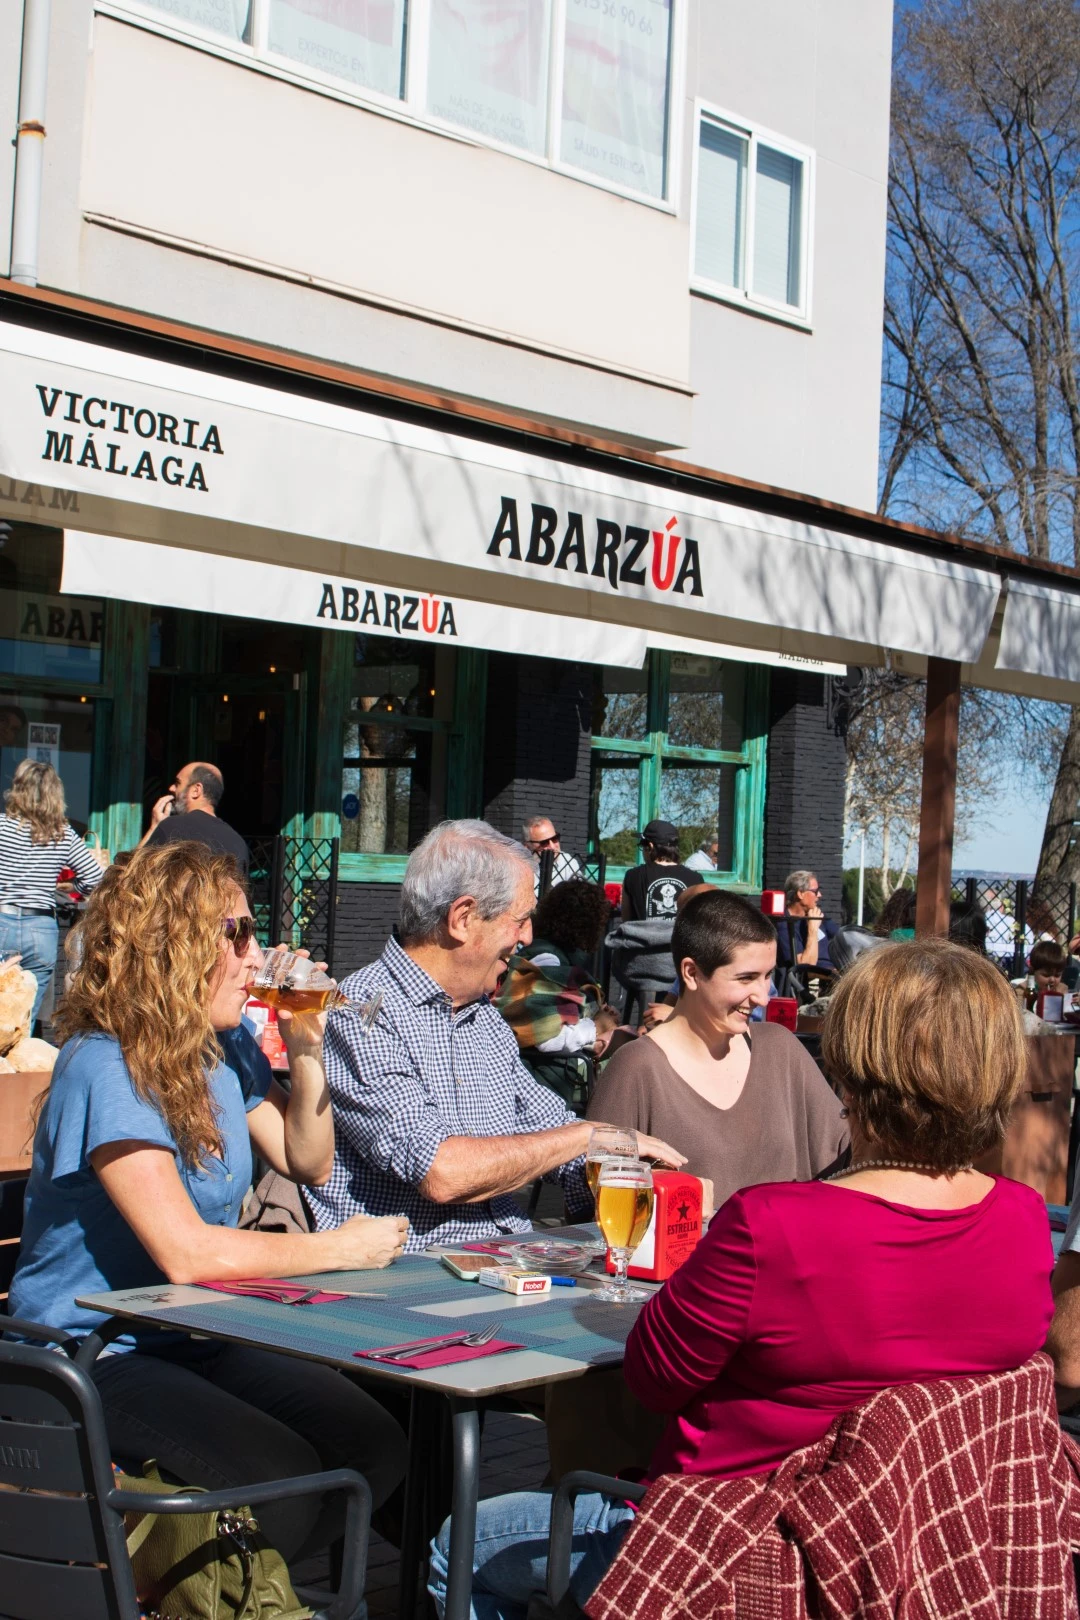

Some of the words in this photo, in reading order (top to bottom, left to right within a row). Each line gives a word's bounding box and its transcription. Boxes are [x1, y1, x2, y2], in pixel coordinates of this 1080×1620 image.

[35, 384, 224, 455] VICTORIA
[41, 430, 209, 492] MÁLAGA
[486, 496, 704, 598] ABARZÚA
[316, 583, 458, 637] ABARZÚA
[667, 1221, 698, 1235] ESTRELLA
[524, 1281, 543, 1290] Nobel
